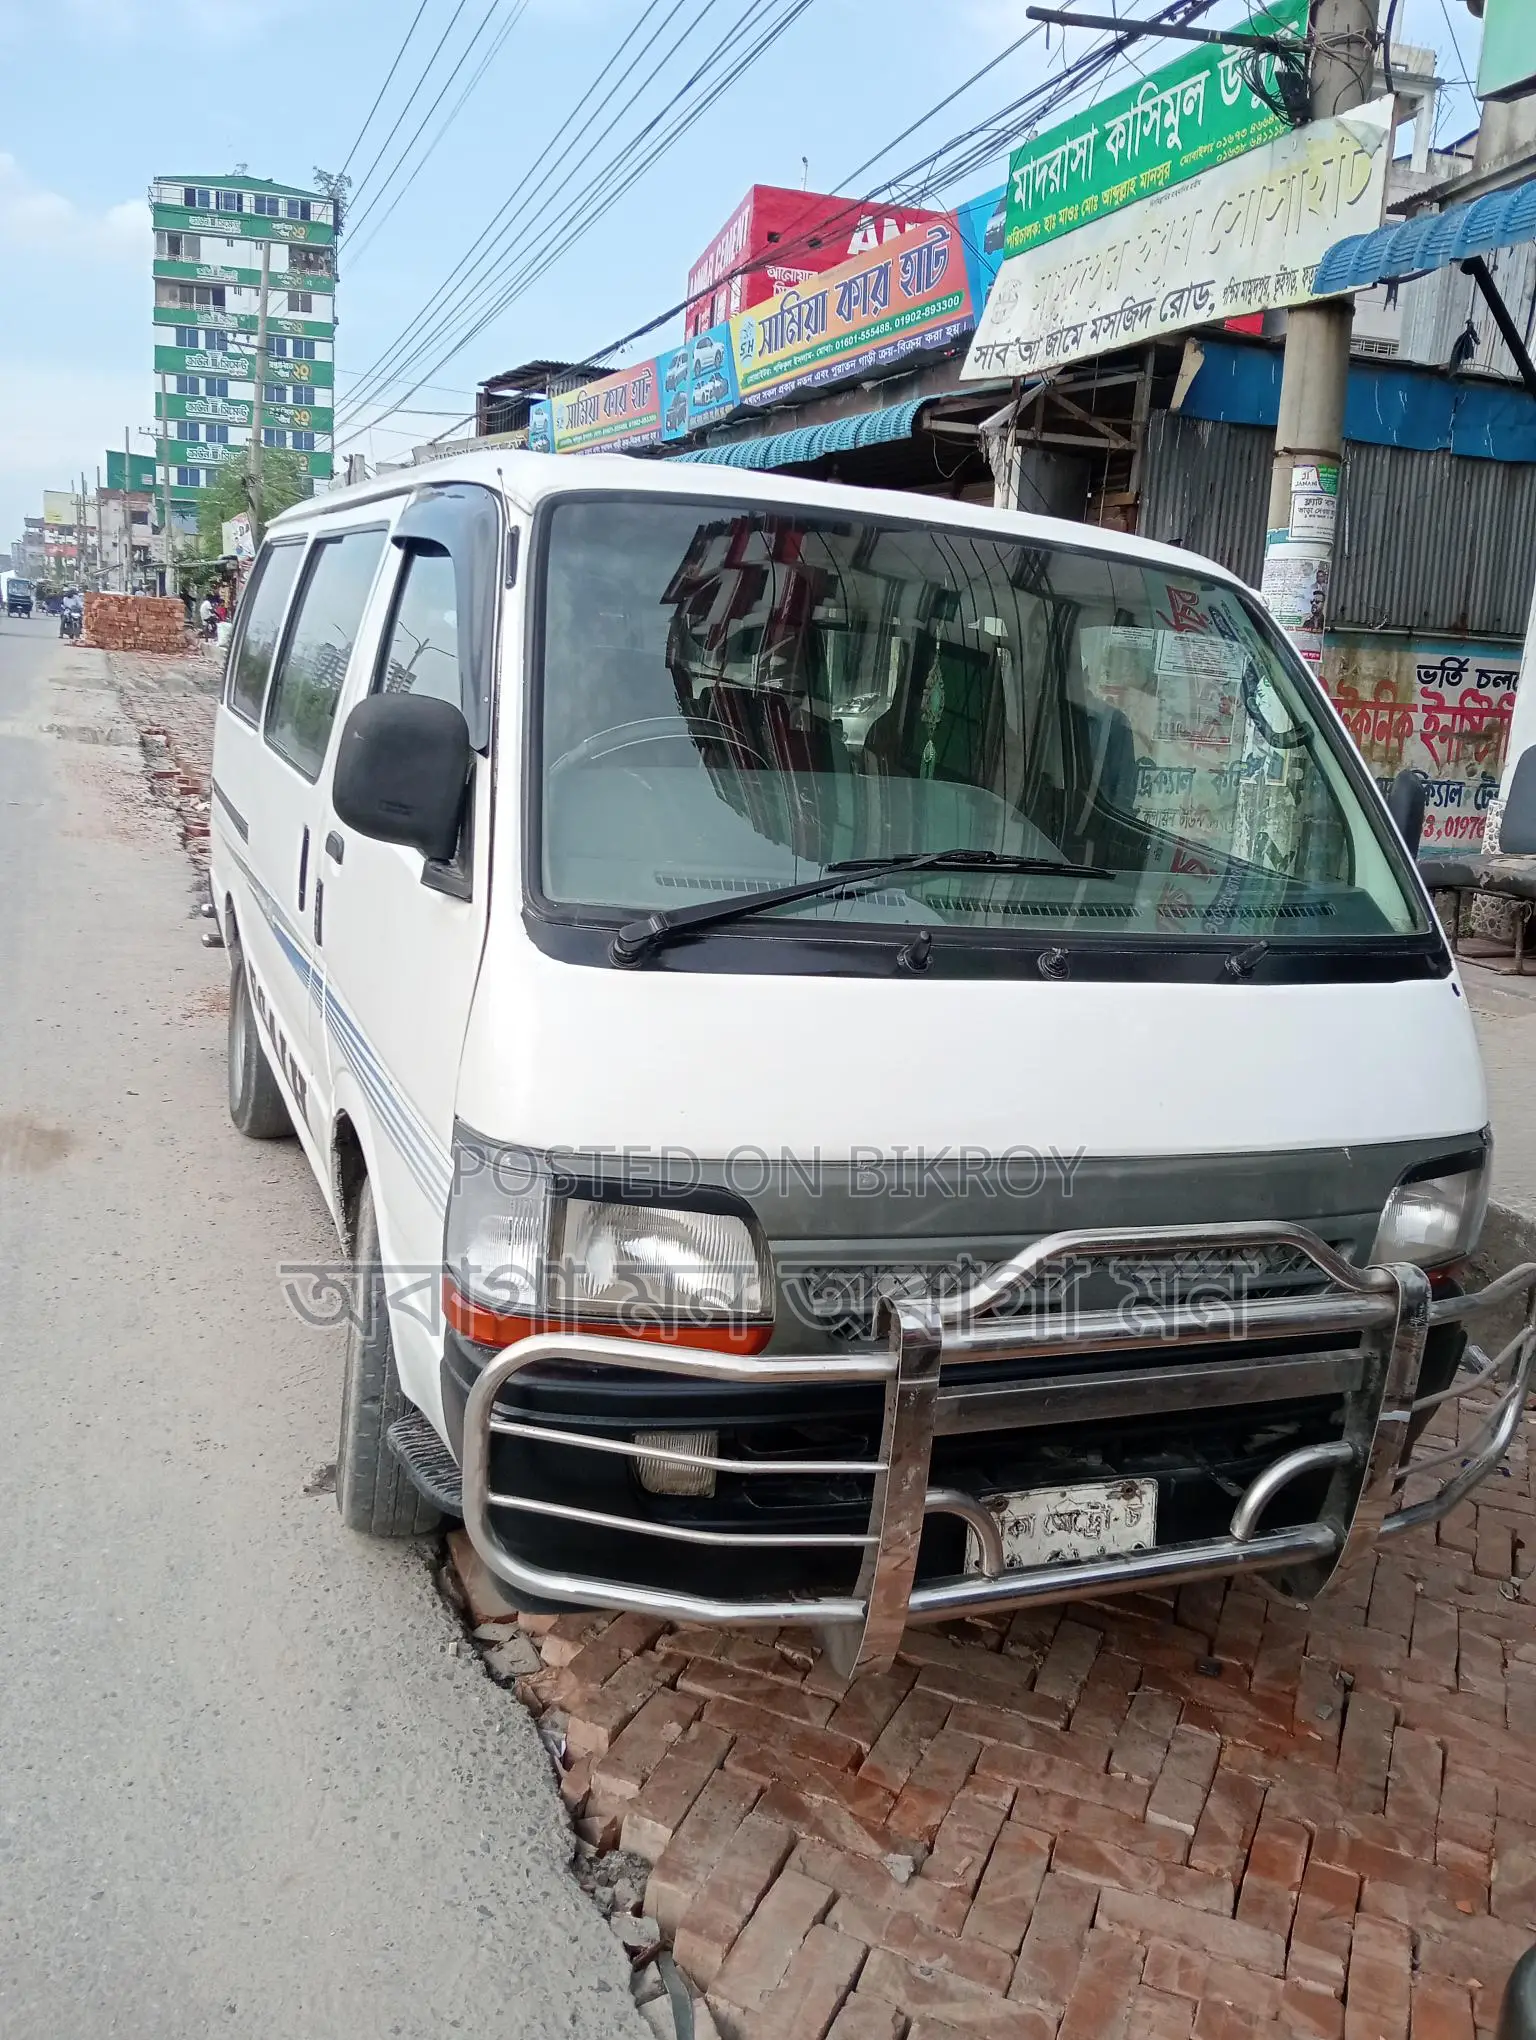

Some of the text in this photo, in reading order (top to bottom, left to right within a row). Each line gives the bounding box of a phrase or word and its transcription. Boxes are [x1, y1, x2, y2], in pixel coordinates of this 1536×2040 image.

[1012, 70, 1211, 212] মাদরাসা কাসিমুল
[758, 289, 829, 358] সামিয়া
[834, 259, 893, 324] কার
[898, 224, 952, 298] হাট
[765, 264, 820, 282] আনোয়া
[894, 295, 960, 328] 01902-893300
[1045, 322, 1087, 358] জামে
[1090, 296, 1156, 343] মসজিদ
[1159, 279, 1216, 322] রোড,
[1417, 656, 1470, 689] ভর্তি
